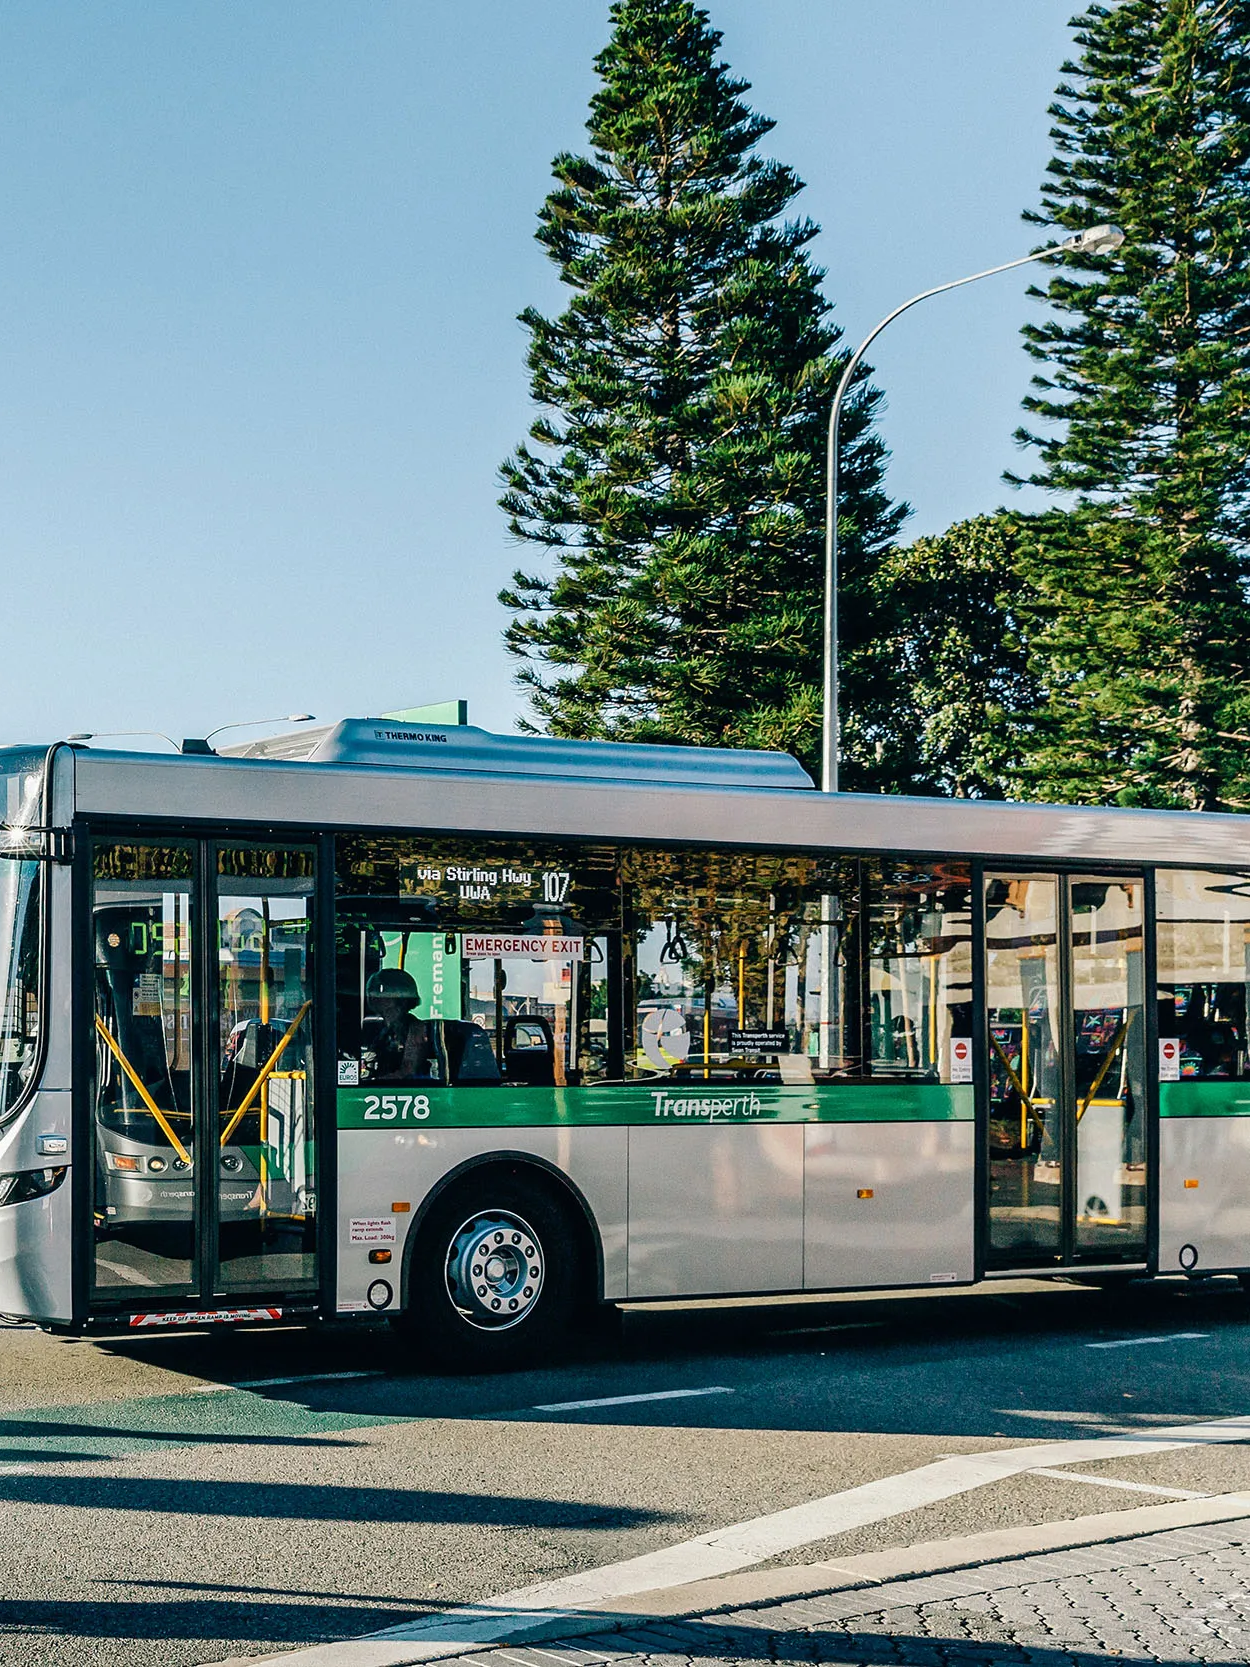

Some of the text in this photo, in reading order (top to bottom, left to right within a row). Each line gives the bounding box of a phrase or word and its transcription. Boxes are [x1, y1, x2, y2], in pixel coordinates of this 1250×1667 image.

[385, 731, 447, 742] THERMO KING
[417, 866, 531, 887] via Stirling Hwy
[542, 872, 570, 902] 107
[460, 885, 491, 900] UWA
[466, 938, 581, 953] EMERGENCY EXIT
[430, 932, 443, 1020] Freman
[364, 1094, 430, 1120] 2578
[650, 1091, 761, 1123] Transperth
